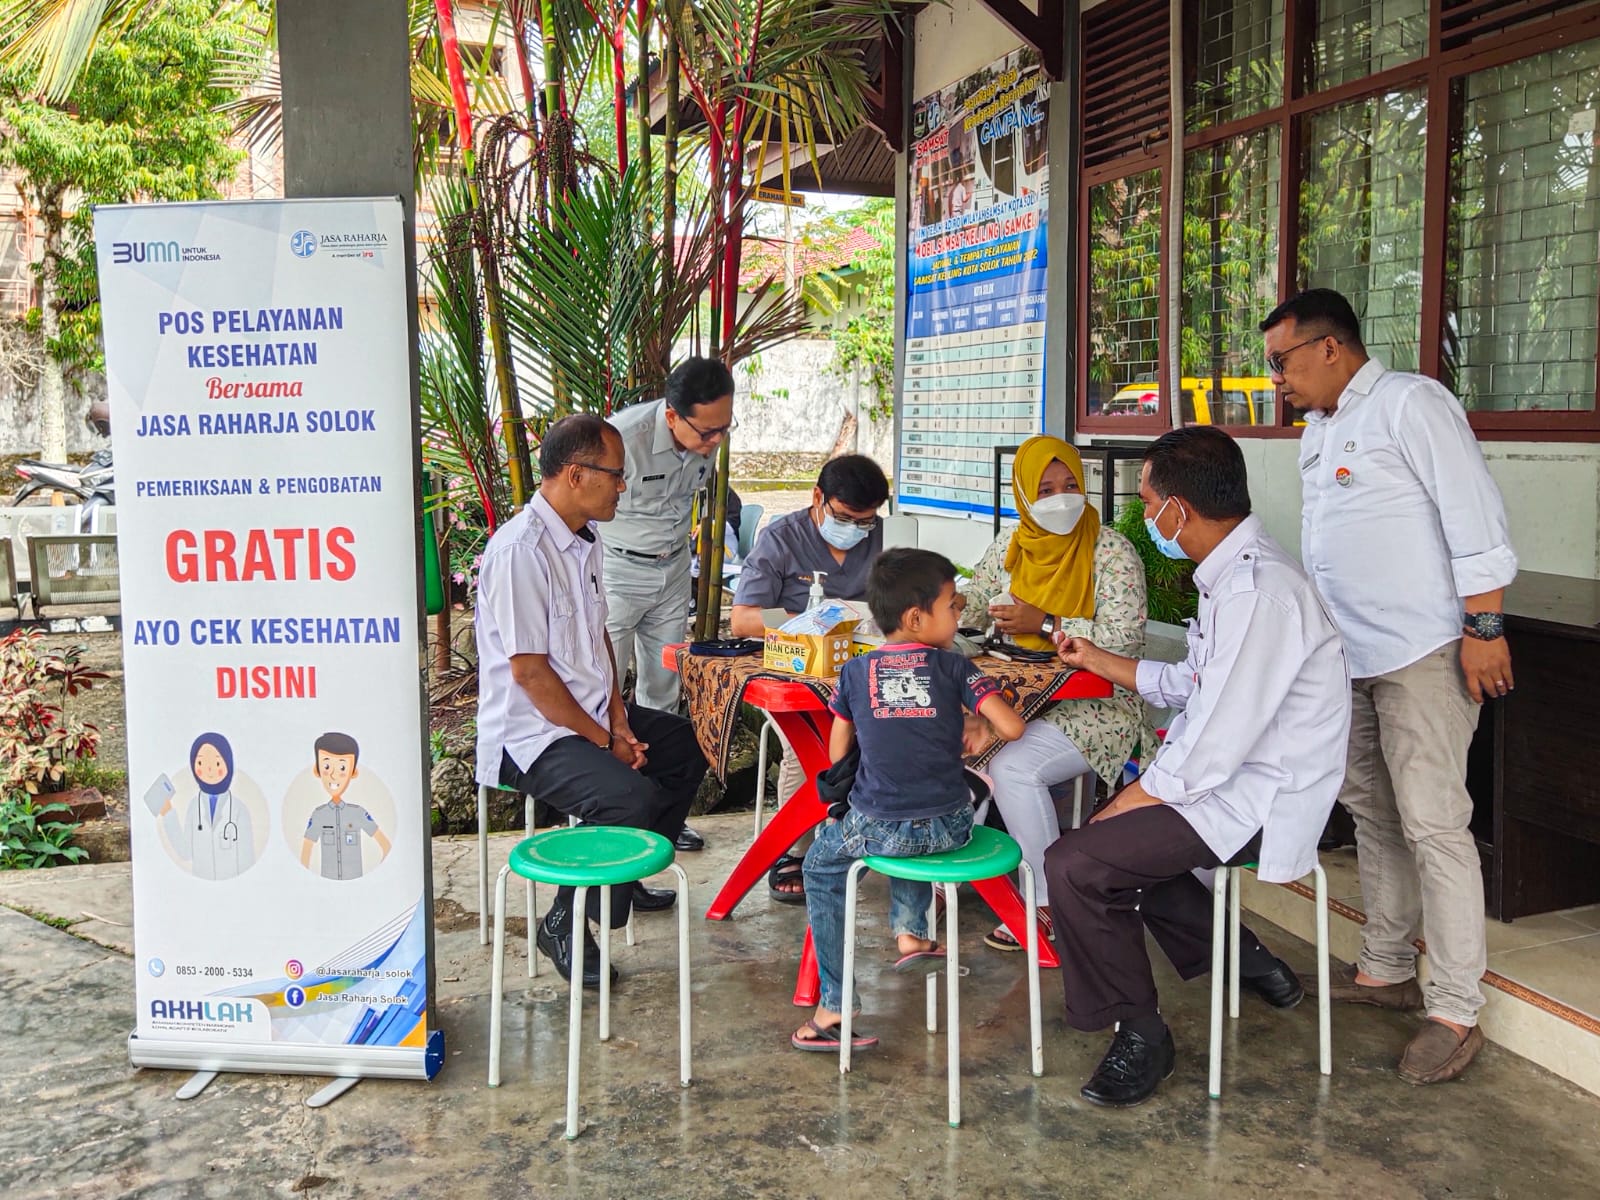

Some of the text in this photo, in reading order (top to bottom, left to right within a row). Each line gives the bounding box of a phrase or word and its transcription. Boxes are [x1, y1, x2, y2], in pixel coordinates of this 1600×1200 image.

[916, 129, 950, 157] SAMSAT
[320, 233, 388, 244] JASA RAHARJA
[182, 254, 221, 262] INDONESIA
[960, 249, 984, 264] TEMPAT
[984, 239, 1020, 257] PELAYANAN
[914, 272, 938, 286] SAMSAT
[962, 263, 978, 276] KOTA
[979, 258, 1000, 273] SOLOK
[1001, 252, 1022, 267] TAHUN
[159, 307, 344, 335] POS PELAYANAN
[188, 342, 318, 369] KESEHATAN
[205, 376, 304, 400] Bersama
[136, 409, 376, 437] JASA RAHARJA SOLOK
[136, 476, 382, 497] PEMERIKSAAN & PENGOBATAN
[165, 526, 357, 583] GRATIS
[134, 617, 401, 646] AYO CEK KESEHATAN
[785, 647, 806, 657] CARE
[216, 665, 317, 699] DISINI
[873, 707, 937, 719] CLASSIC
[176, 965, 197, 976] 0853
[204, 966, 225, 977] 2000
[232, 967, 254, 978] 5334
[316, 966, 412, 980] @Jasaraharja_solok
[150, 999, 253, 1023] AKHLAK
[317, 993, 408, 1005] Jasa Raharja Solok
